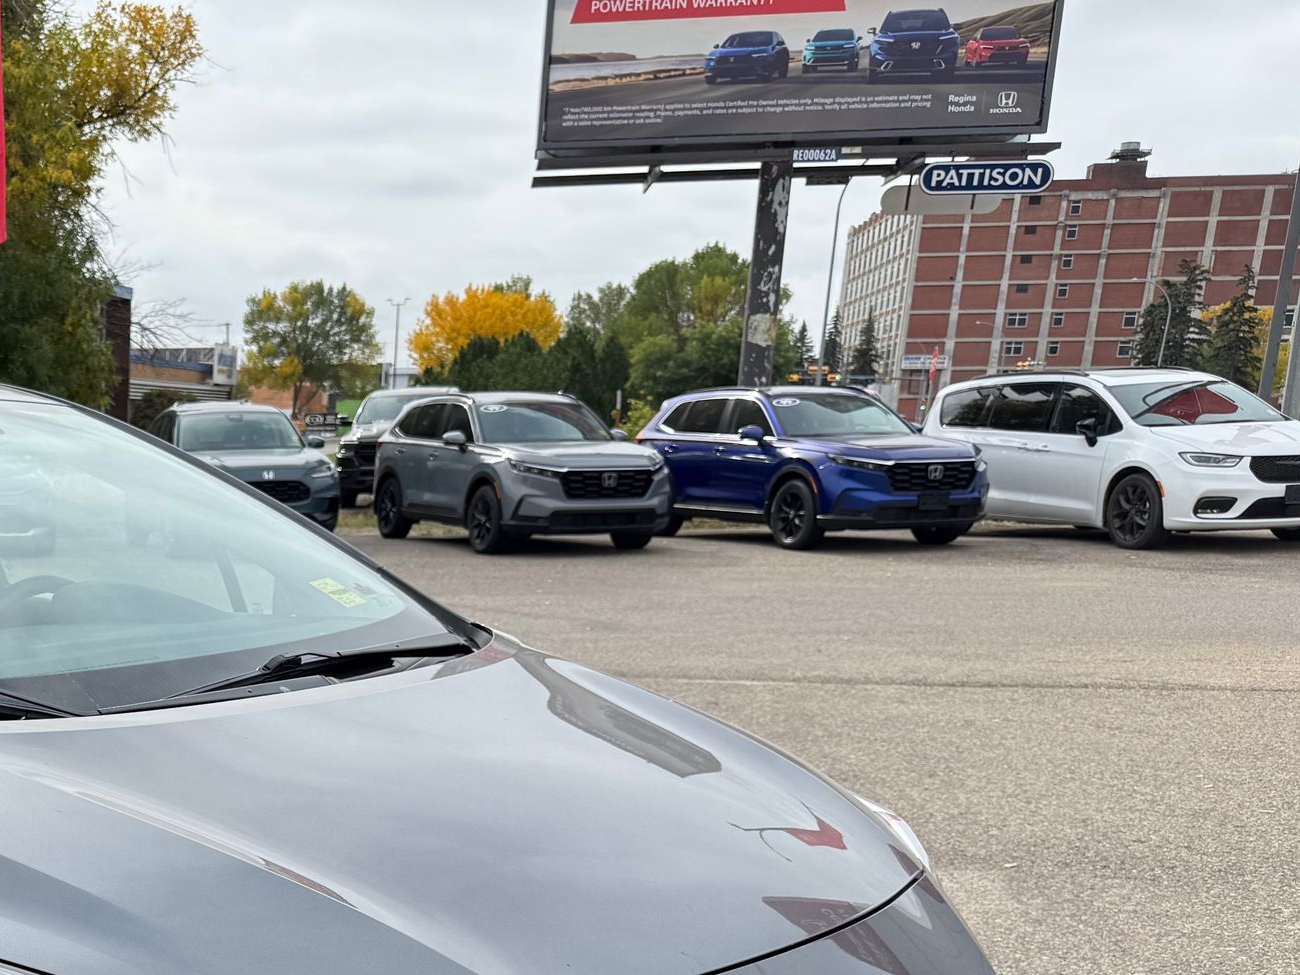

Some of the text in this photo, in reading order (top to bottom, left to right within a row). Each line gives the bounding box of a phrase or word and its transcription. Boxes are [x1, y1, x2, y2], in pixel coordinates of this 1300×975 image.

[591, 0, 687, 13] POWERTRAIN
[948, 94, 976, 104] Regina
[948, 104, 974, 113] Honda
[792, 149, 836, 161] RE00062A
[930, 167, 1043, 187] PATTISON
